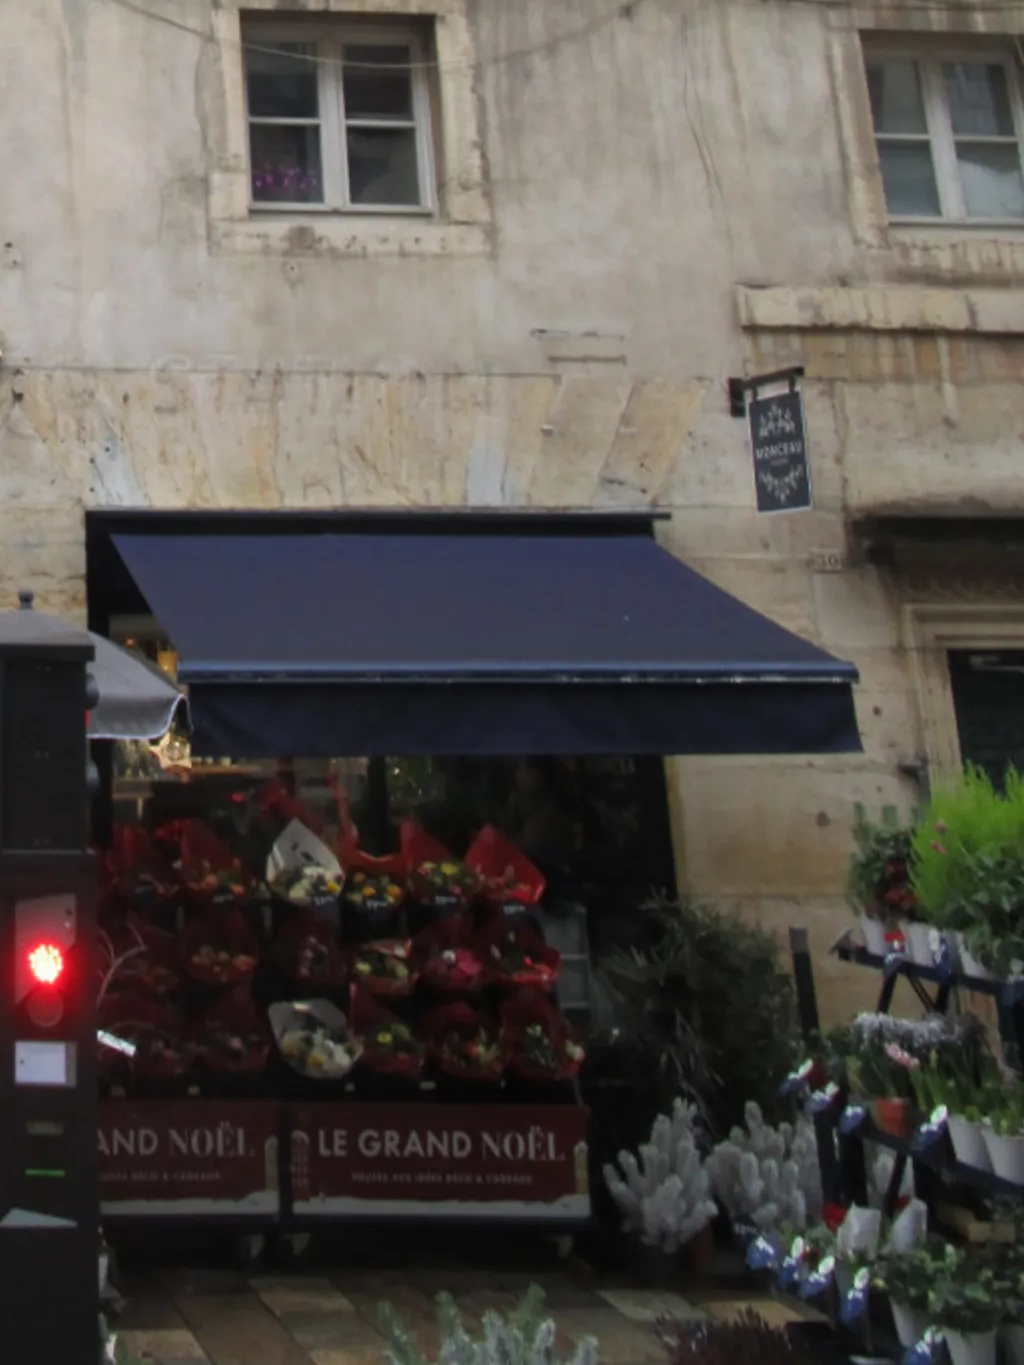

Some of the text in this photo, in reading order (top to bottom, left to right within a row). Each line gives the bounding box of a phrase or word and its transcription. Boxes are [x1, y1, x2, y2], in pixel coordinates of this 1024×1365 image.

[168, 1119, 256, 1158] NOËL
[317, 1124, 566, 1162] LE GRAND NOËL
